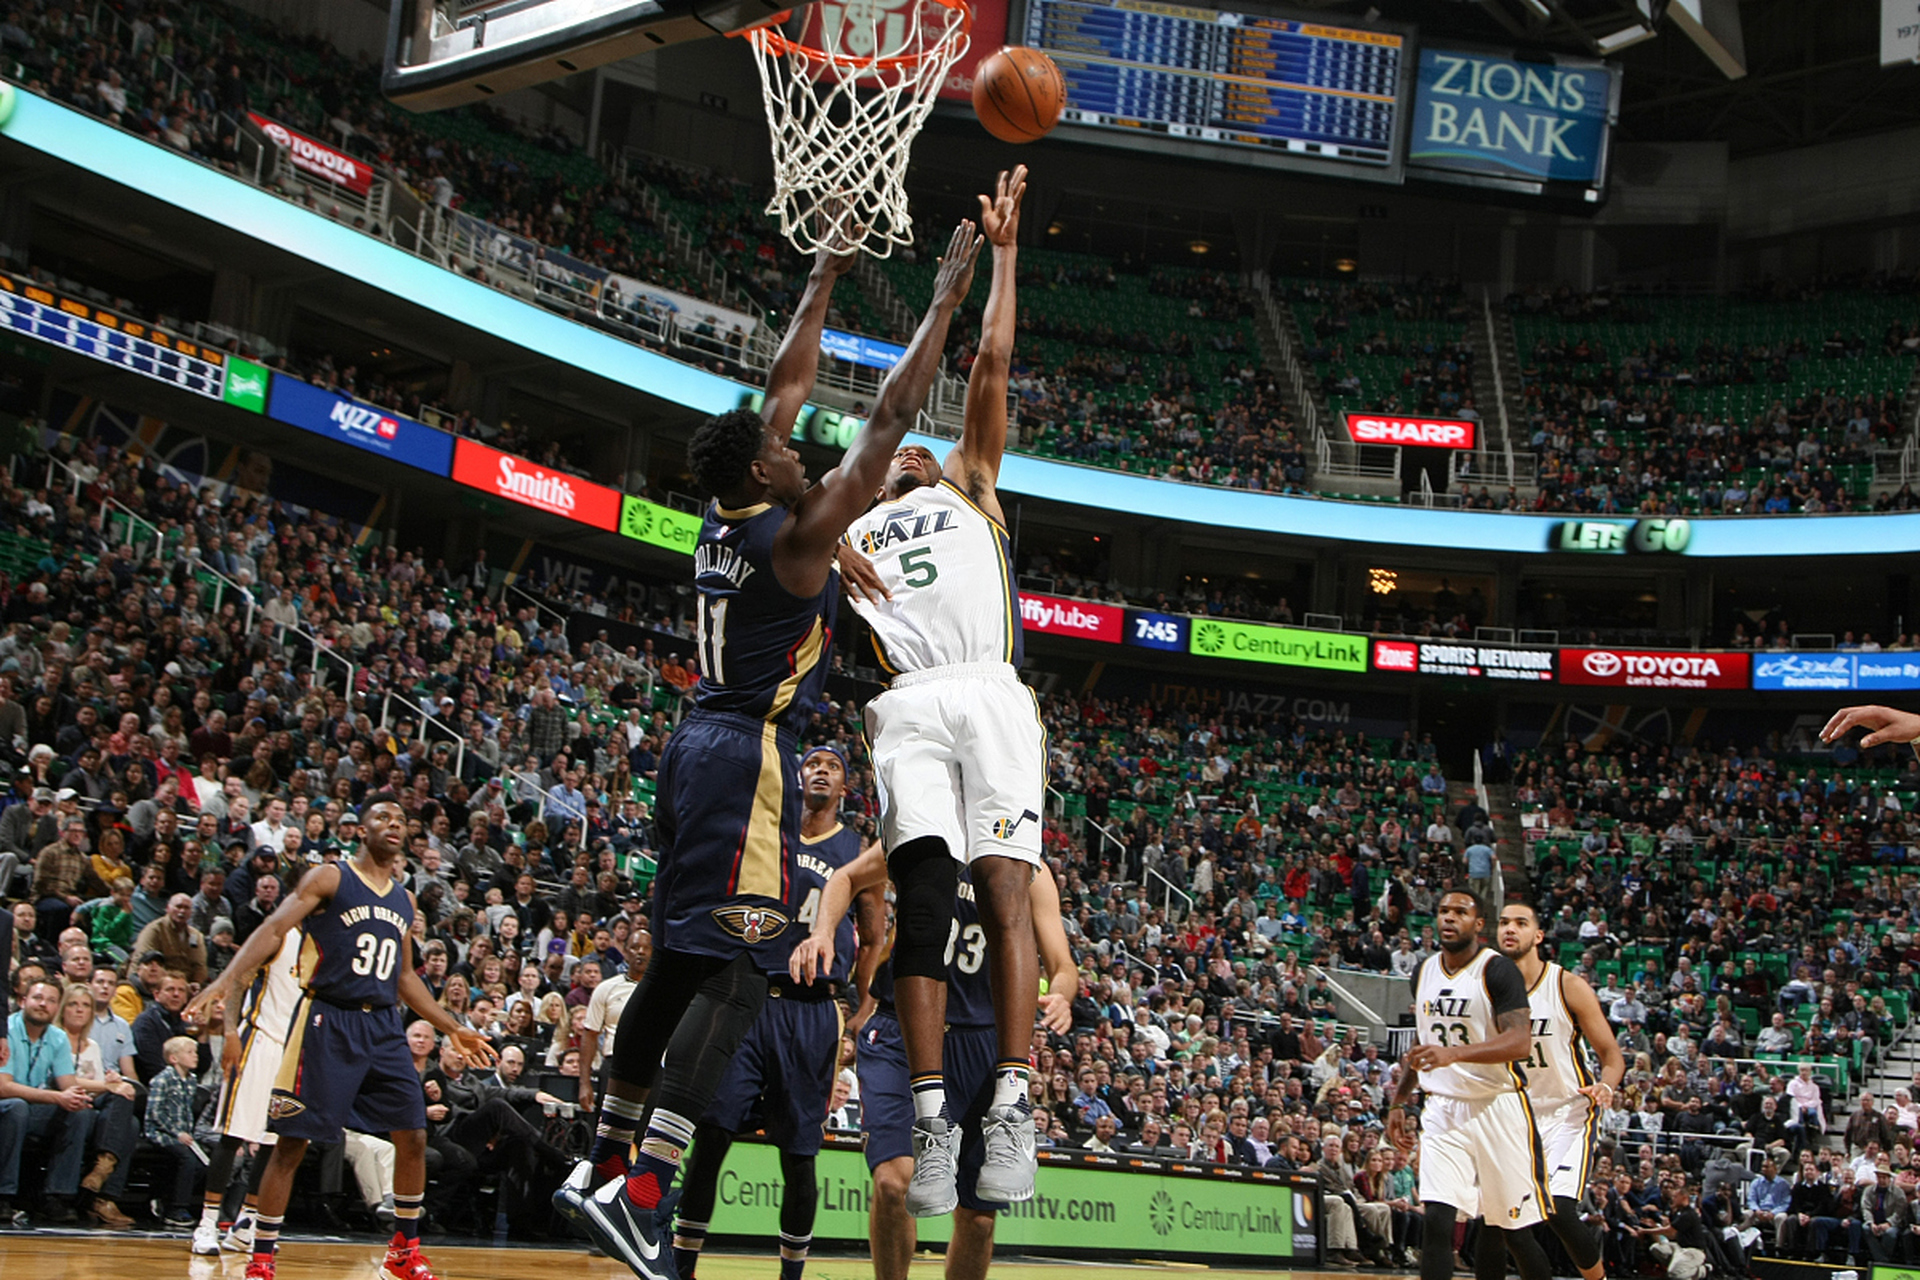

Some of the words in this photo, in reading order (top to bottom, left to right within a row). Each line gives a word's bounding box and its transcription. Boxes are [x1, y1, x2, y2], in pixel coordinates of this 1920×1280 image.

[1897, 24, 1920, 39] 197
[1431, 54, 1586, 112] ZIONS
[1426, 101, 1579, 162] BANK
[290, 136, 357, 179] TOYOTA
[811, 408, 863, 449] GO
[1356, 420, 1465, 443] SHARP
[496, 456, 576, 511] Smith's
[861, 508, 959, 555] JAZZ
[1560, 521, 1629, 549] LETS
[1633, 518, 1691, 552] GO
[542, 556, 594, 592] WE
[898, 546, 938, 588] 5
[1018, 597, 1101, 631] iffylube
[1135, 618, 1178, 643] 7:45
[696, 593, 729, 685] 11
[1233, 631, 1362, 663] CenturyLink
[1419, 644, 1477, 666] SPORTS
[1478, 648, 1553, 670] NETWORK
[1622, 655, 1721, 676] TOYOTA
[796, 853, 836, 881] RLEA
[340, 905, 371, 928] NEW
[373, 905, 408, 938] ORLEA
[352, 932, 397, 981] 30
[1423, 988, 1472, 1018] JAZZ
[719, 1170, 873, 1214] CentLin
[1180, 1200, 1284, 1238] CenturyLink
